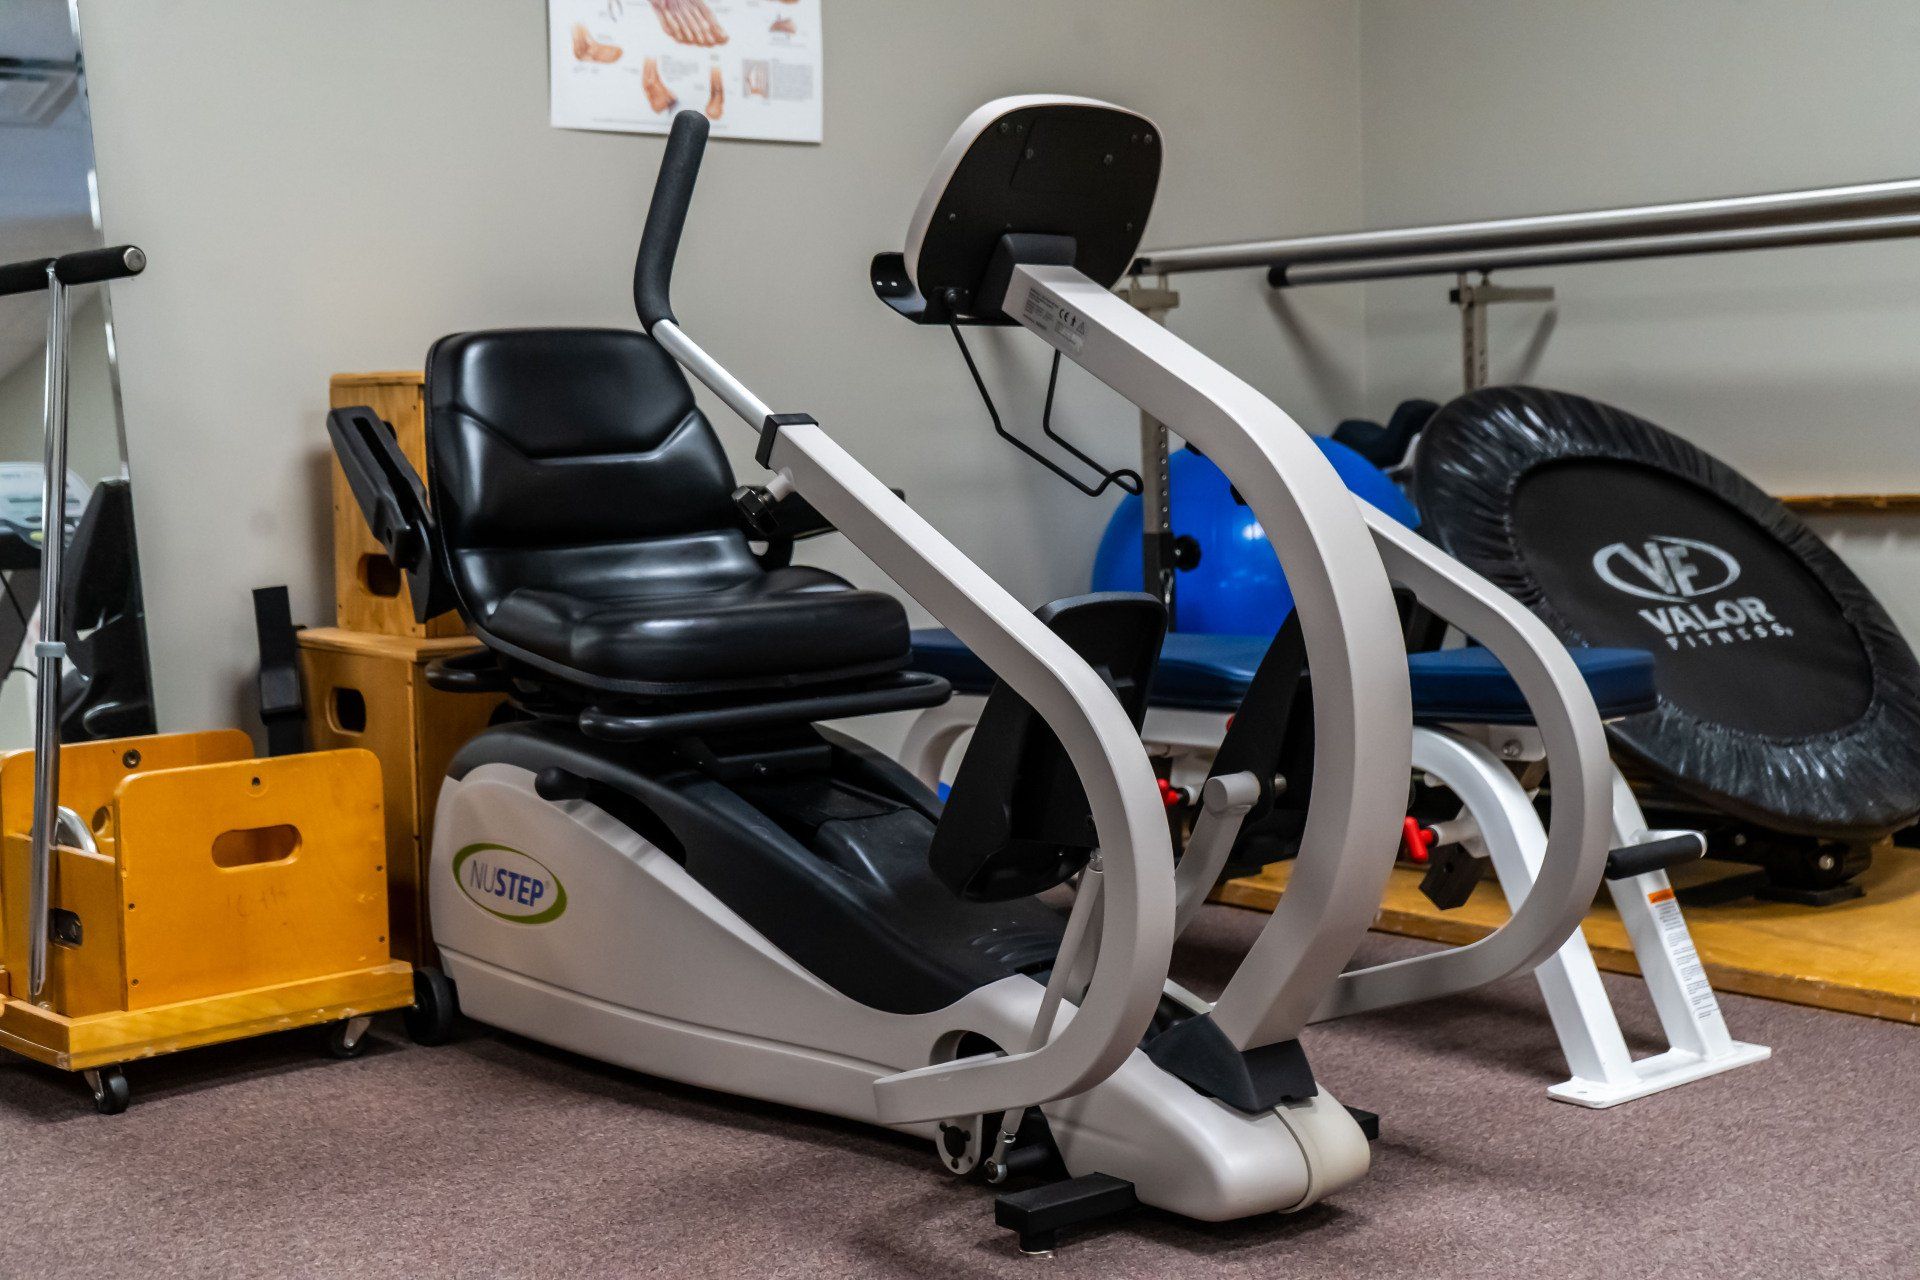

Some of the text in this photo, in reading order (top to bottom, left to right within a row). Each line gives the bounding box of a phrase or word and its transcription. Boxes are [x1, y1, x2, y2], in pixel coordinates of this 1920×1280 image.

[1638, 597, 1776, 635] VALOR
[1666, 622, 1788, 650] FITNESS
[470, 860, 544, 907] NUSTEP
